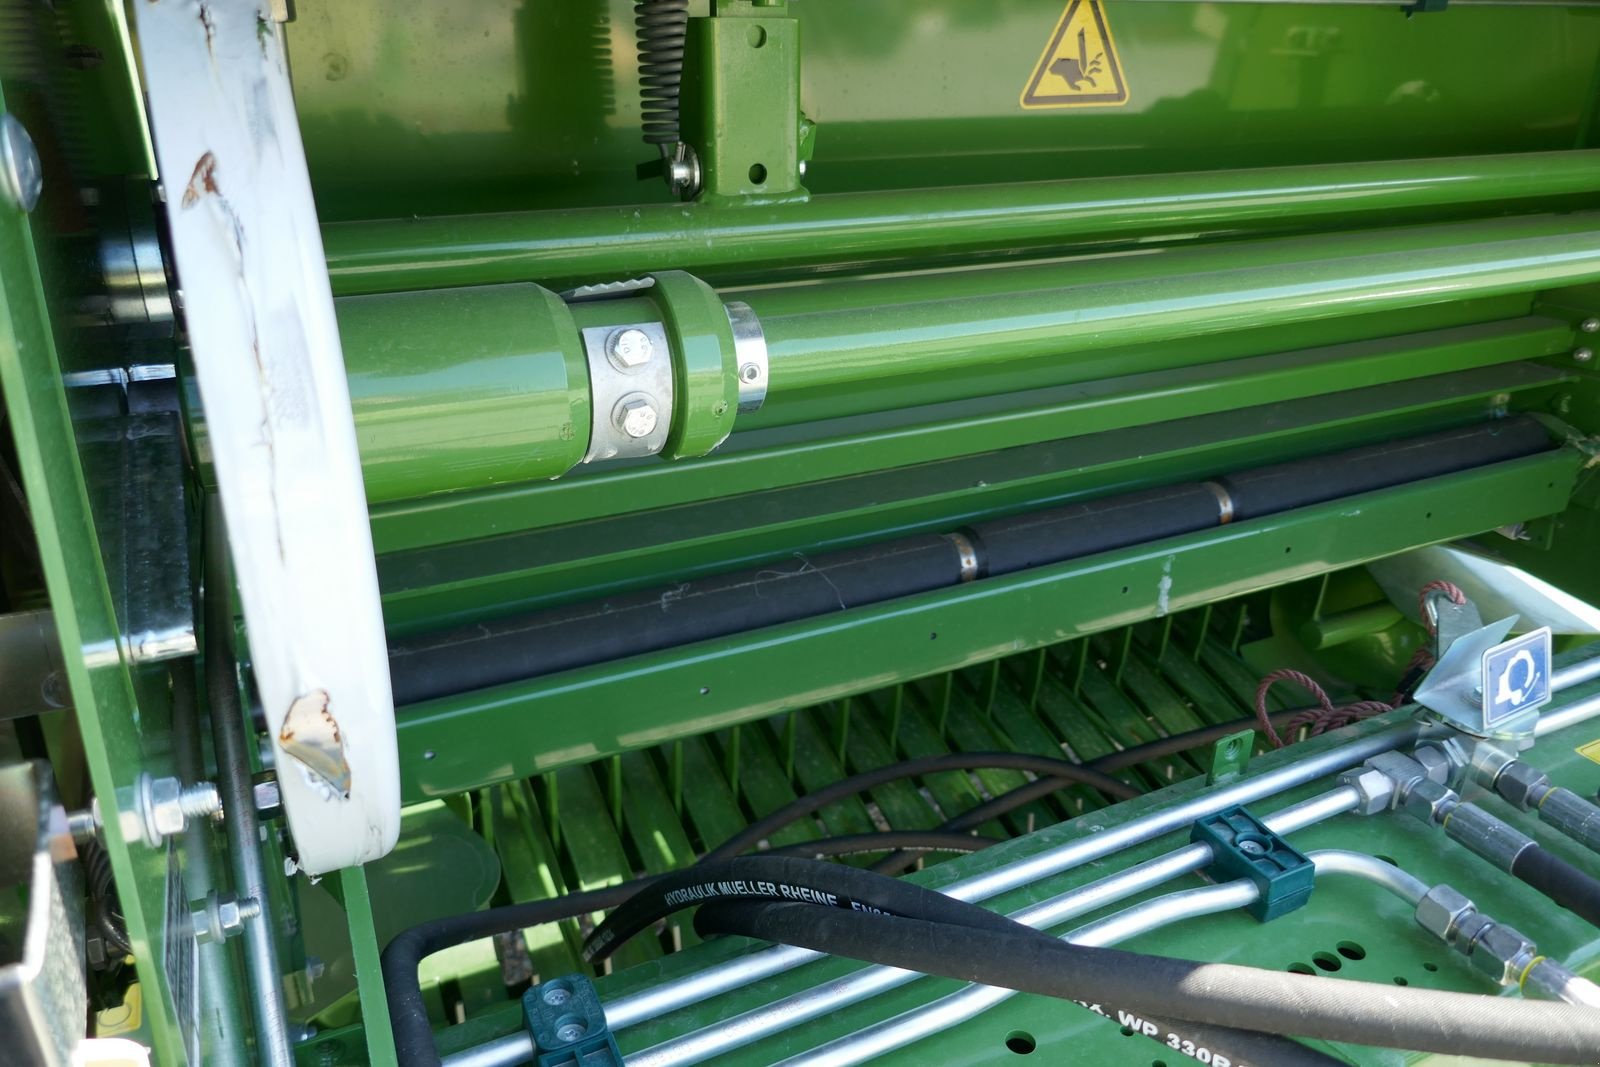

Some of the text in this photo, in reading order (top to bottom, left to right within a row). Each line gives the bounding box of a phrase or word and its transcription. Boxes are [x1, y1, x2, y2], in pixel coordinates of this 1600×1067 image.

[664, 882, 720, 906] HYDRAULIK
[718, 880, 780, 897] MUELLER
[779, 884, 838, 906] RHEINE
[1117, 1009, 1159, 1037] WP
